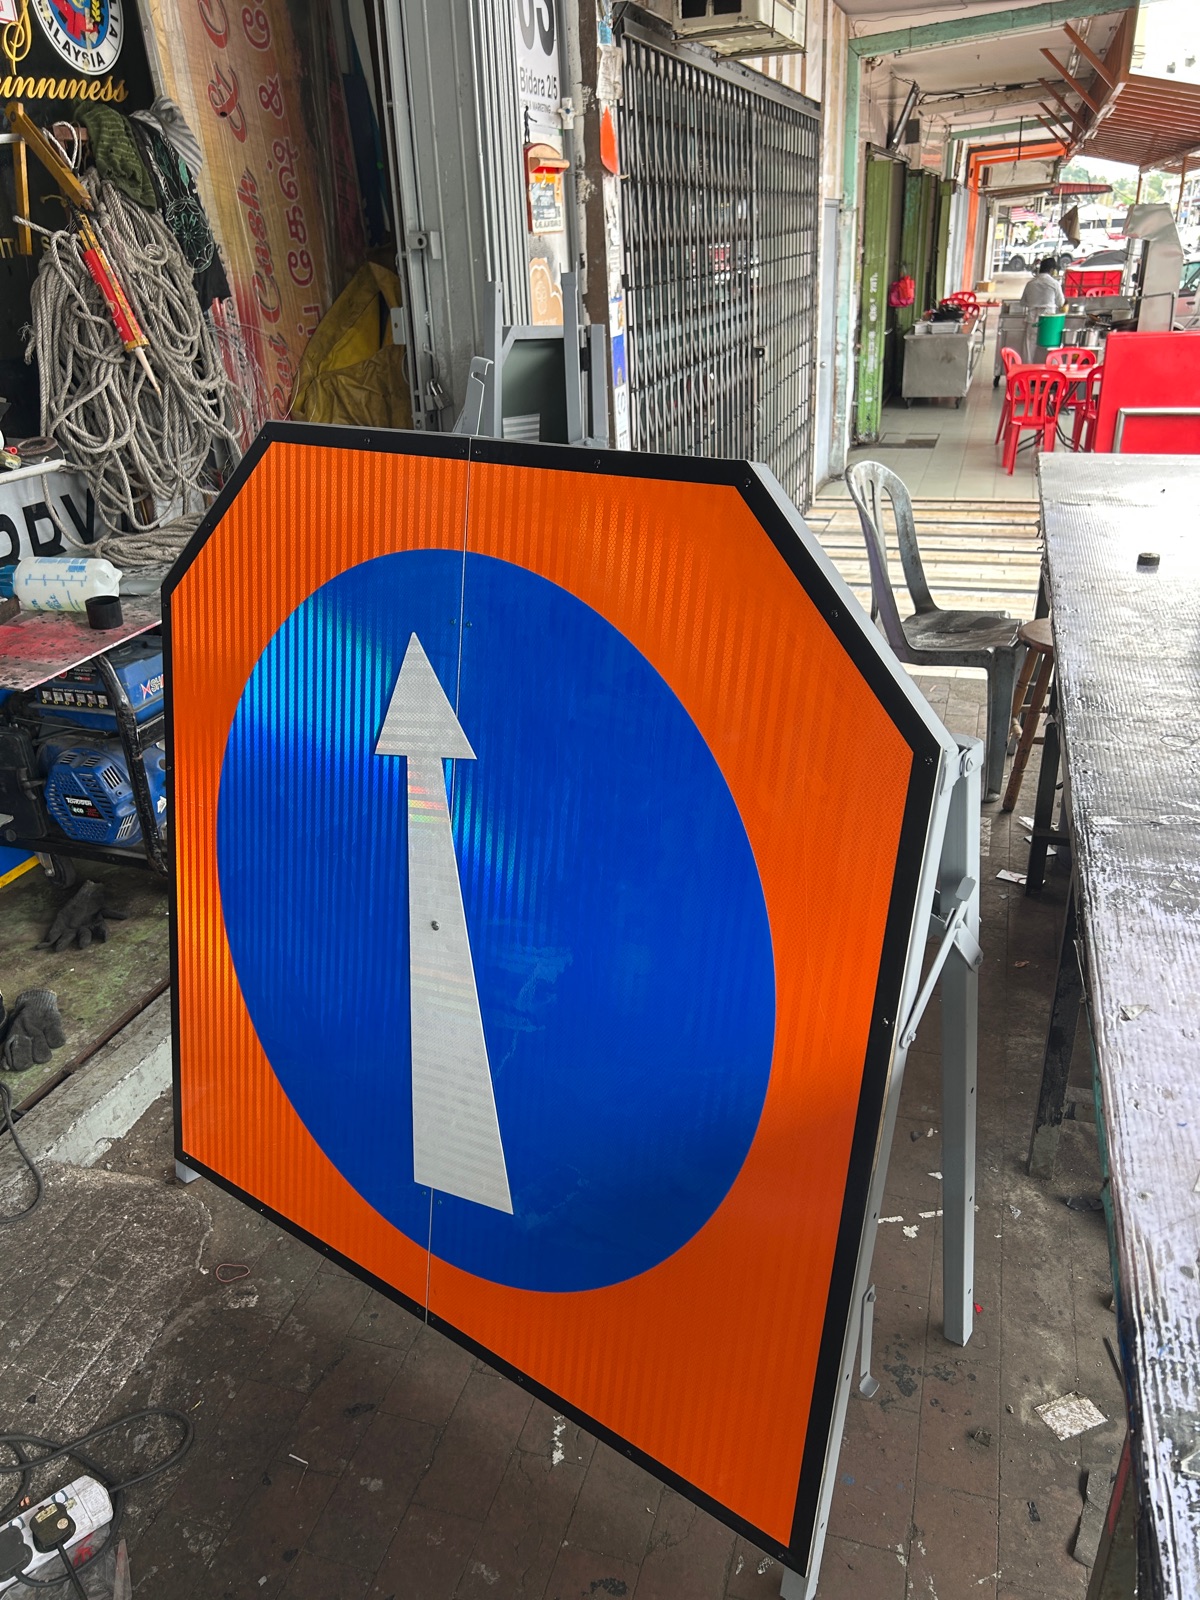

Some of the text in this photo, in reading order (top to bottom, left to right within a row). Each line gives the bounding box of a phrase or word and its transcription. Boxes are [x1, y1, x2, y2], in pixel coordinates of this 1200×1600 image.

[208, 61, 247, 143] &
[258, 73, 284, 119] &
[520, 66, 545, 97] Bidara
[236, 167, 282, 324] Cash
